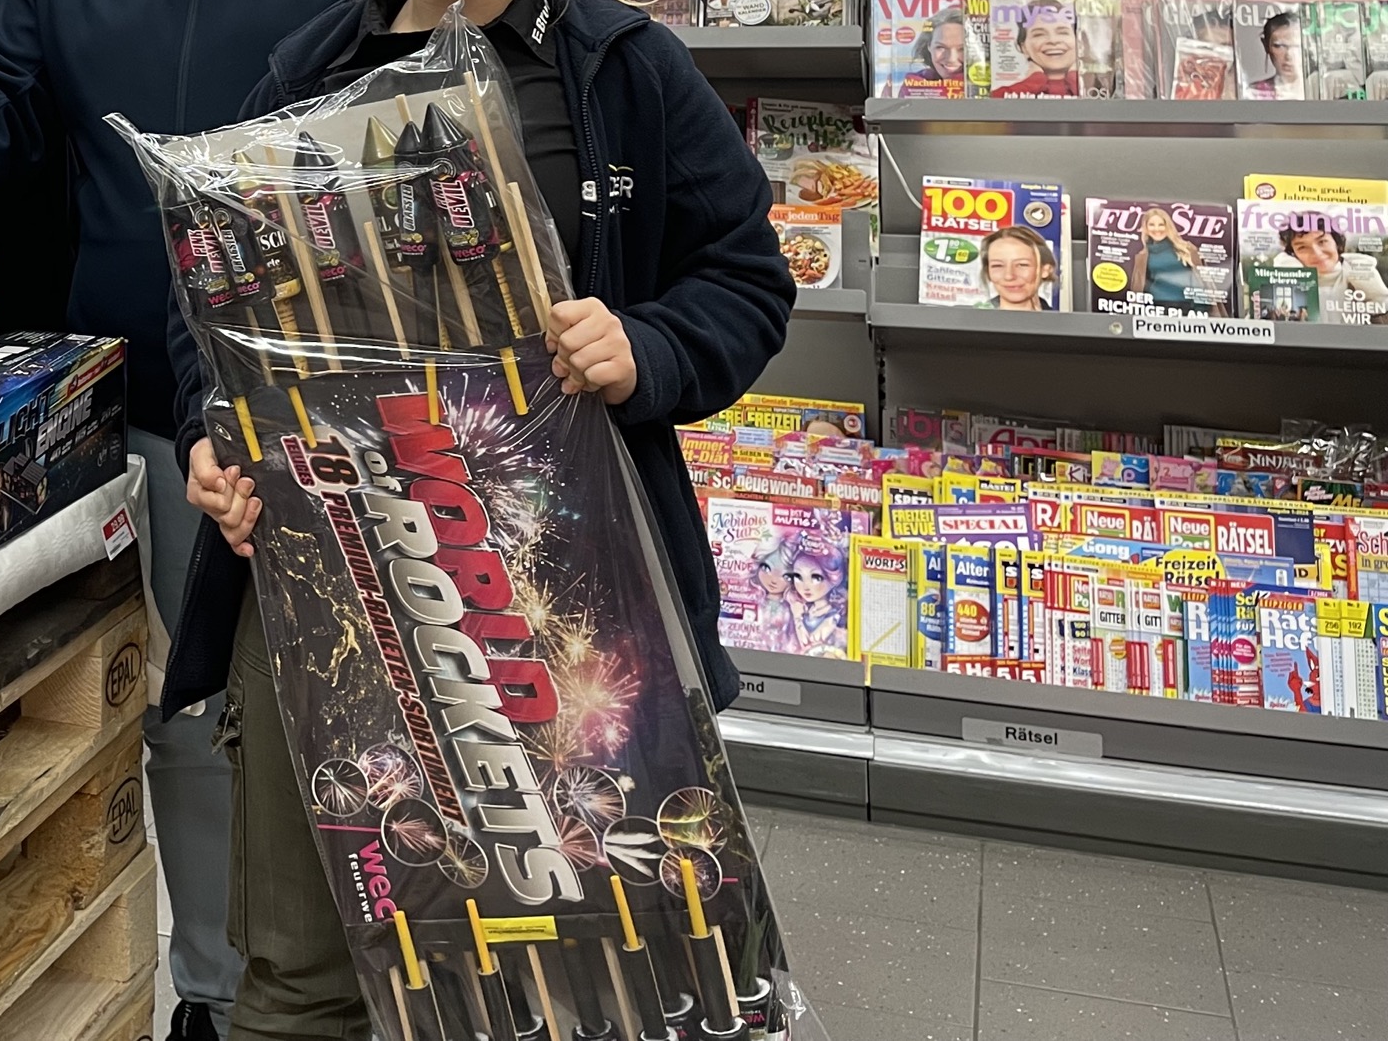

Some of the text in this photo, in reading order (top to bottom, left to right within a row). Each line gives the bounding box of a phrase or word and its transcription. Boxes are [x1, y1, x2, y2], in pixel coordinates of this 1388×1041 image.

[1298, 184, 1316, 193] Das
[443, 180, 475, 228] DEVIL
[925, 188, 1008, 221] 100
[308, 203, 335, 249] DEVIL
[931, 214, 999, 232] RÄTSEL
[1241, 205, 1386, 234] freundin
[188, 229, 208, 256] PINK
[1254, 269, 1311, 278] Miteinander
[1126, 291, 1153, 304] DER
[1343, 289, 1366, 301] SO
[1097, 298, 1165, 317] RICHTIGE
[1326, 300, 1386, 312] BLEIBEN
[1135, 320, 1271, 337] Premium Women
[1341, 314, 1371, 325] WIR
[36, 387, 94, 459] ENGINE
[362, 450, 402, 494] of
[711, 511, 767, 529] Nebulous
[894, 521, 936, 535] REVUE
[942, 518, 1024, 531] SPECIAL
[1086, 512, 1124, 529] Neue
[1170, 517, 1209, 535] Neue
[1170, 535, 1210, 550] Post
[1218, 519, 1272, 555] RÄTSEL
[1083, 537, 1129, 558] Gong
[375, 390, 562, 724] WORLD
[1156, 556, 1218, 571] Freizeit
[957, 604, 977, 616] 440
[111, 658, 138, 695] EPAL
[360, 492, 584, 905] ROCKETS
[1005, 726, 1058, 745] Rätsel
[111, 788, 139, 844] EPAL
[356, 840, 398, 922] wec
